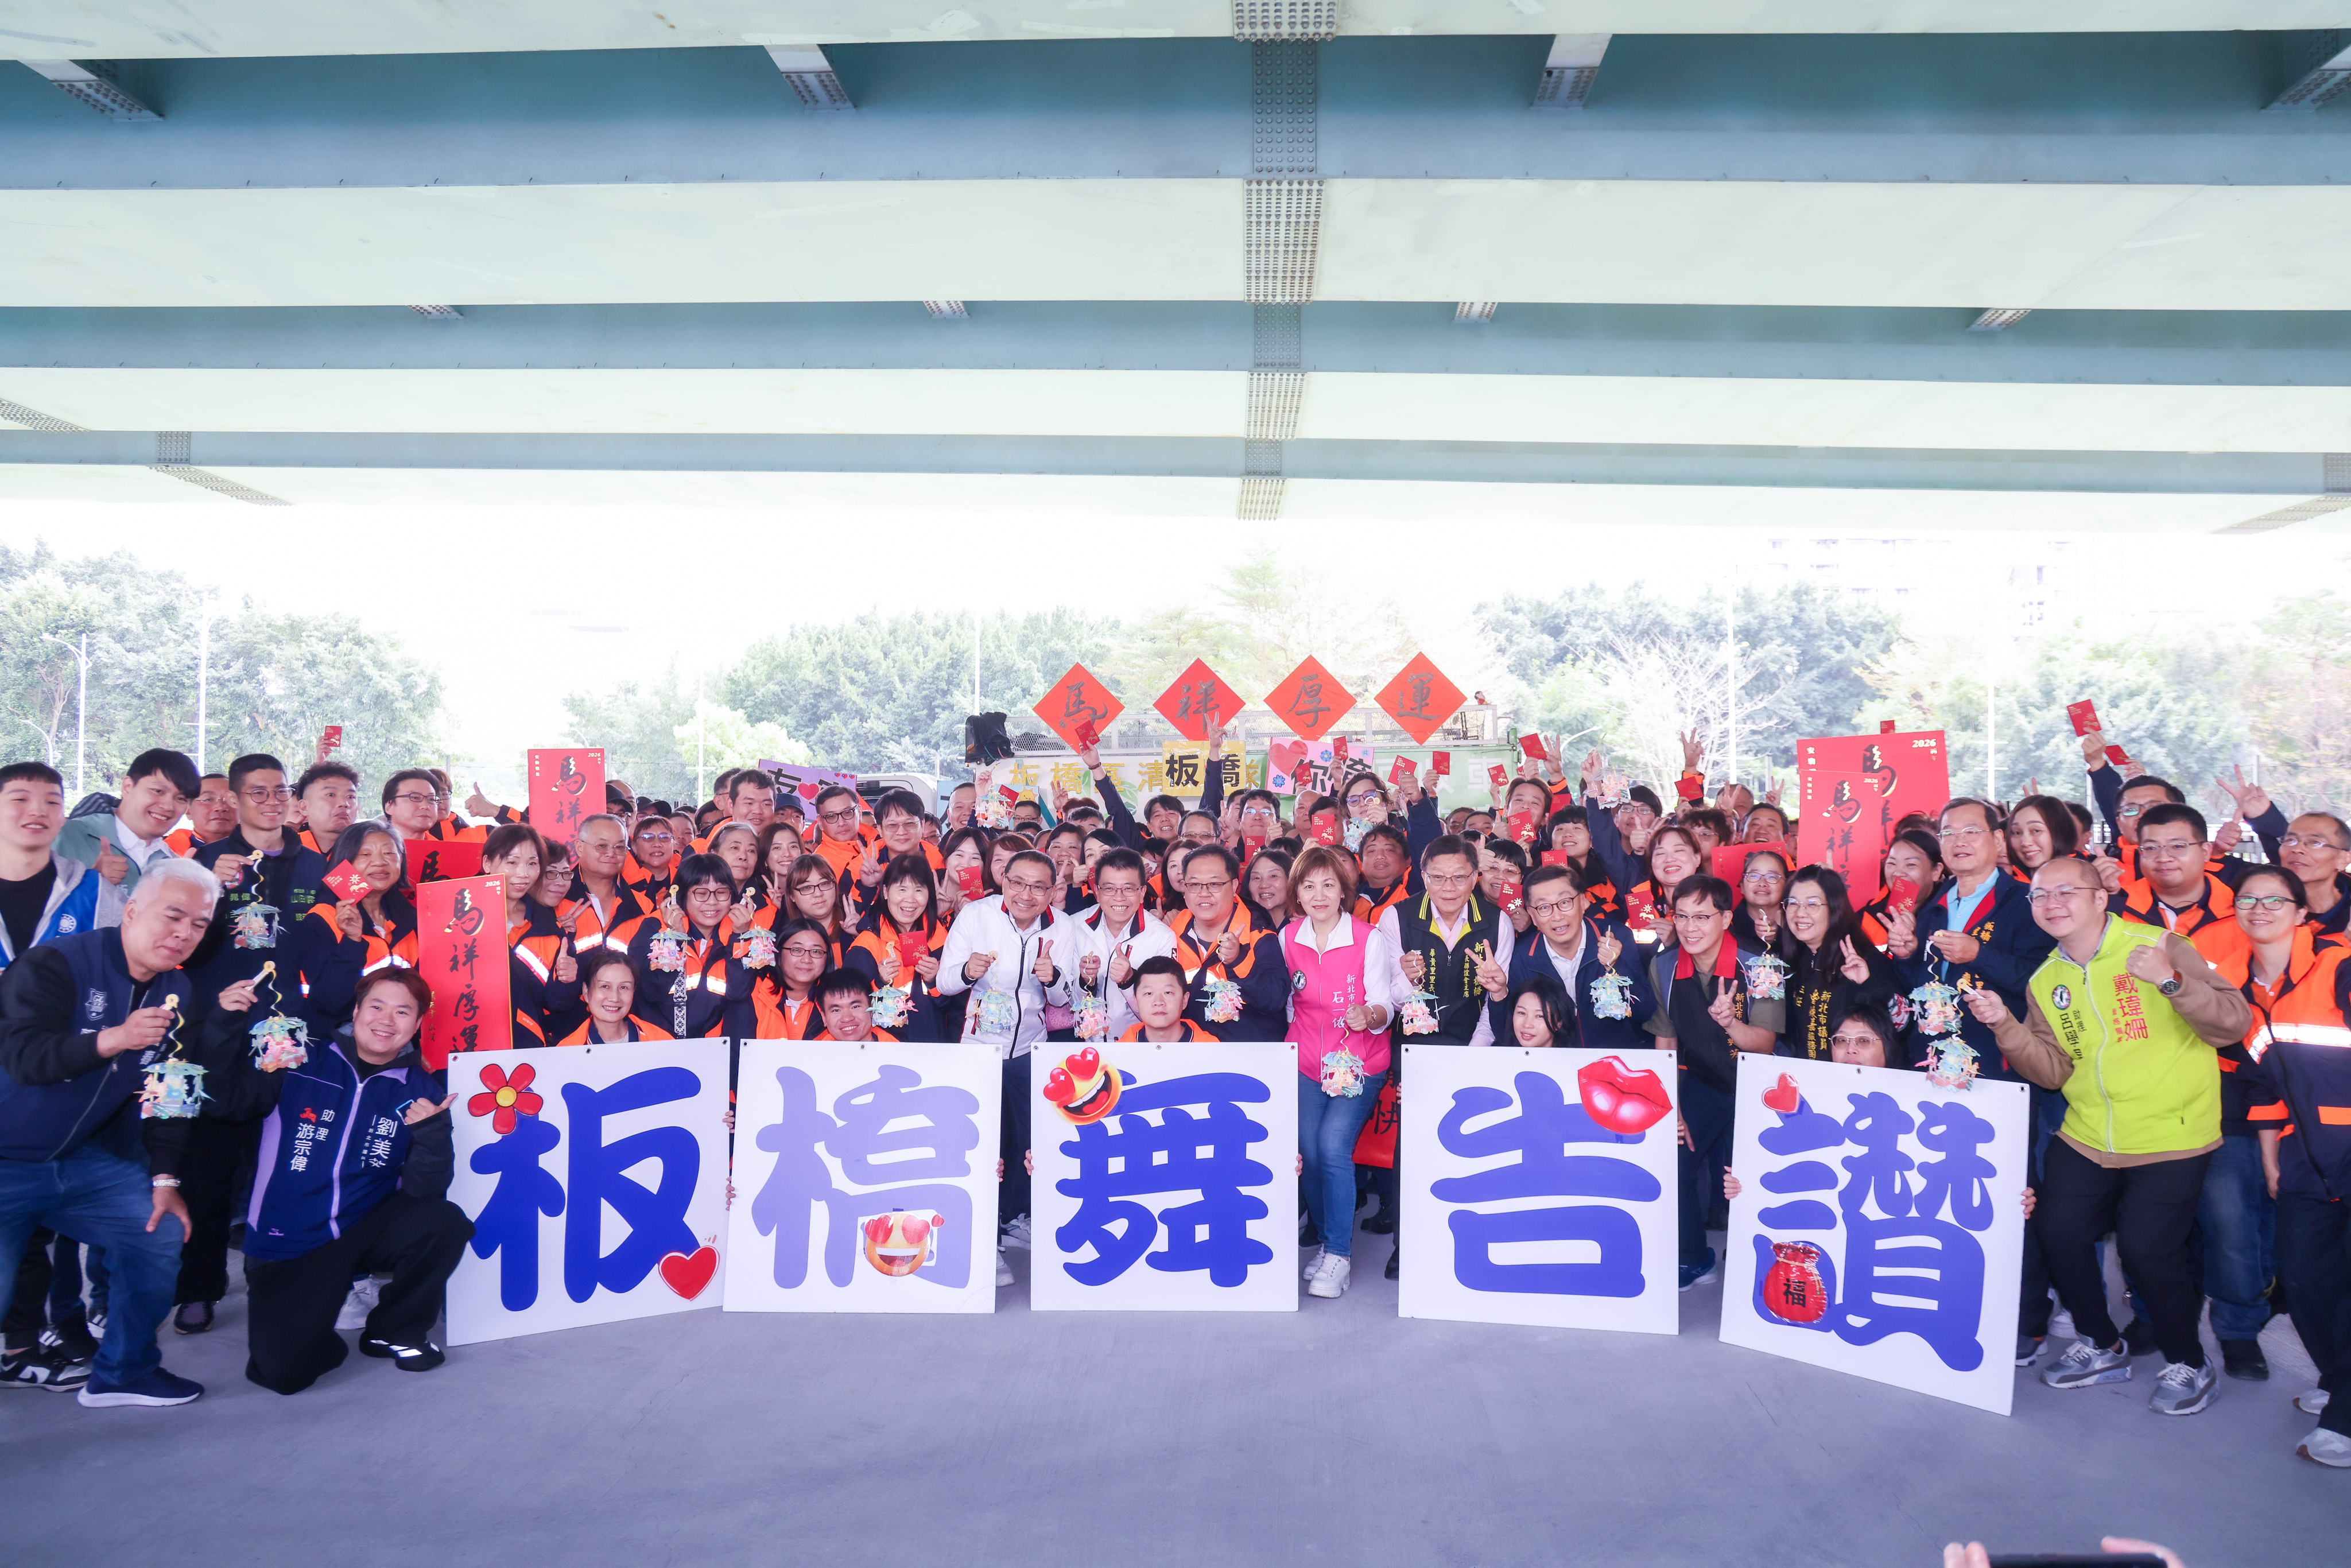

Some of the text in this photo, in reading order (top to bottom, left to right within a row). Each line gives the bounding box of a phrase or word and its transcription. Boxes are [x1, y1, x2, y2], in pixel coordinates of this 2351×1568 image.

[1059, 681, 1108, 729] 馬
[1176, 679, 1220, 735] 祥
[1286, 673, 1331, 728] 厚
[1397, 672, 1440, 720] 運
[1912, 739, 1936, 747] 2026
[1346, 973, 1356, 1008] 新北市
[290, 1122, 316, 1173] 游宗偉
[470, 1066, 701, 1312] 板
[751, 1064, 980, 1289] 橋
[1055, 1069, 1274, 1288] 舞
[1429, 1070, 1662, 1298] 告
[1752, 1090, 1998, 1372] 讚
[1783, 1278, 1807, 1308] 福
